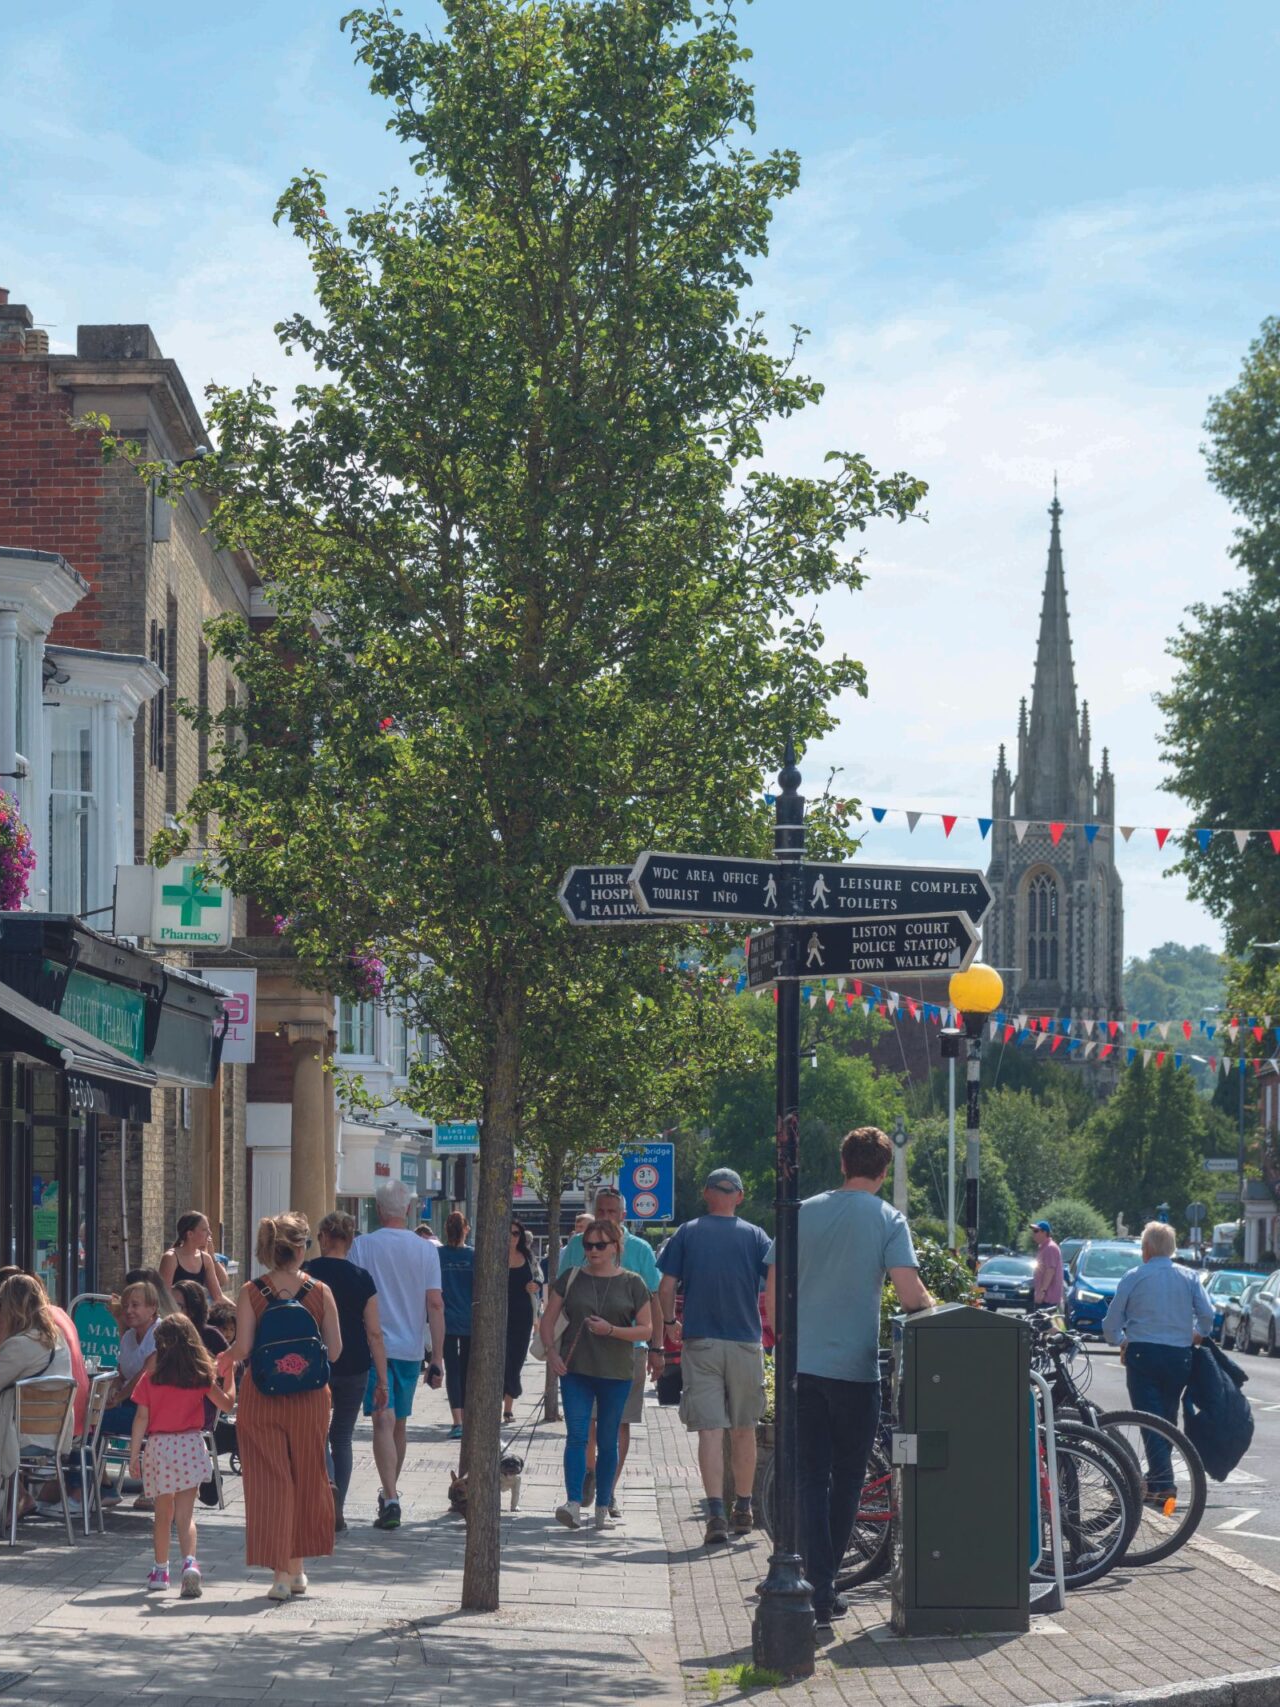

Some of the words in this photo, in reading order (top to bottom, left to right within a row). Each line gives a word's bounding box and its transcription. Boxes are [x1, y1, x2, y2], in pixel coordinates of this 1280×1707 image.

[590, 874, 629, 885] LIBR
[652, 867, 679, 880] WDC
[686, 870, 715, 882] AREA
[723, 872, 759, 885] OFFICE
[840, 878, 902, 892] LEISURE
[911, 881, 978, 895] COMPLEX
[652, 887, 699, 901] TOURIST
[713, 891, 738, 903] INFO
[838, 896, 898, 910] TOILETS
[591, 904, 641, 916] RAILW
[160, 927, 221, 943] Pharmacy
[852, 924, 897, 938] LISTON
[905, 922, 950, 935] COURT
[852, 941, 896, 954] POLICE
[904, 937, 957, 951] STATION
[849, 958, 885, 971] TOWN
[895, 955, 930, 968] WALK
[646, 1147, 671, 1156] bridge
